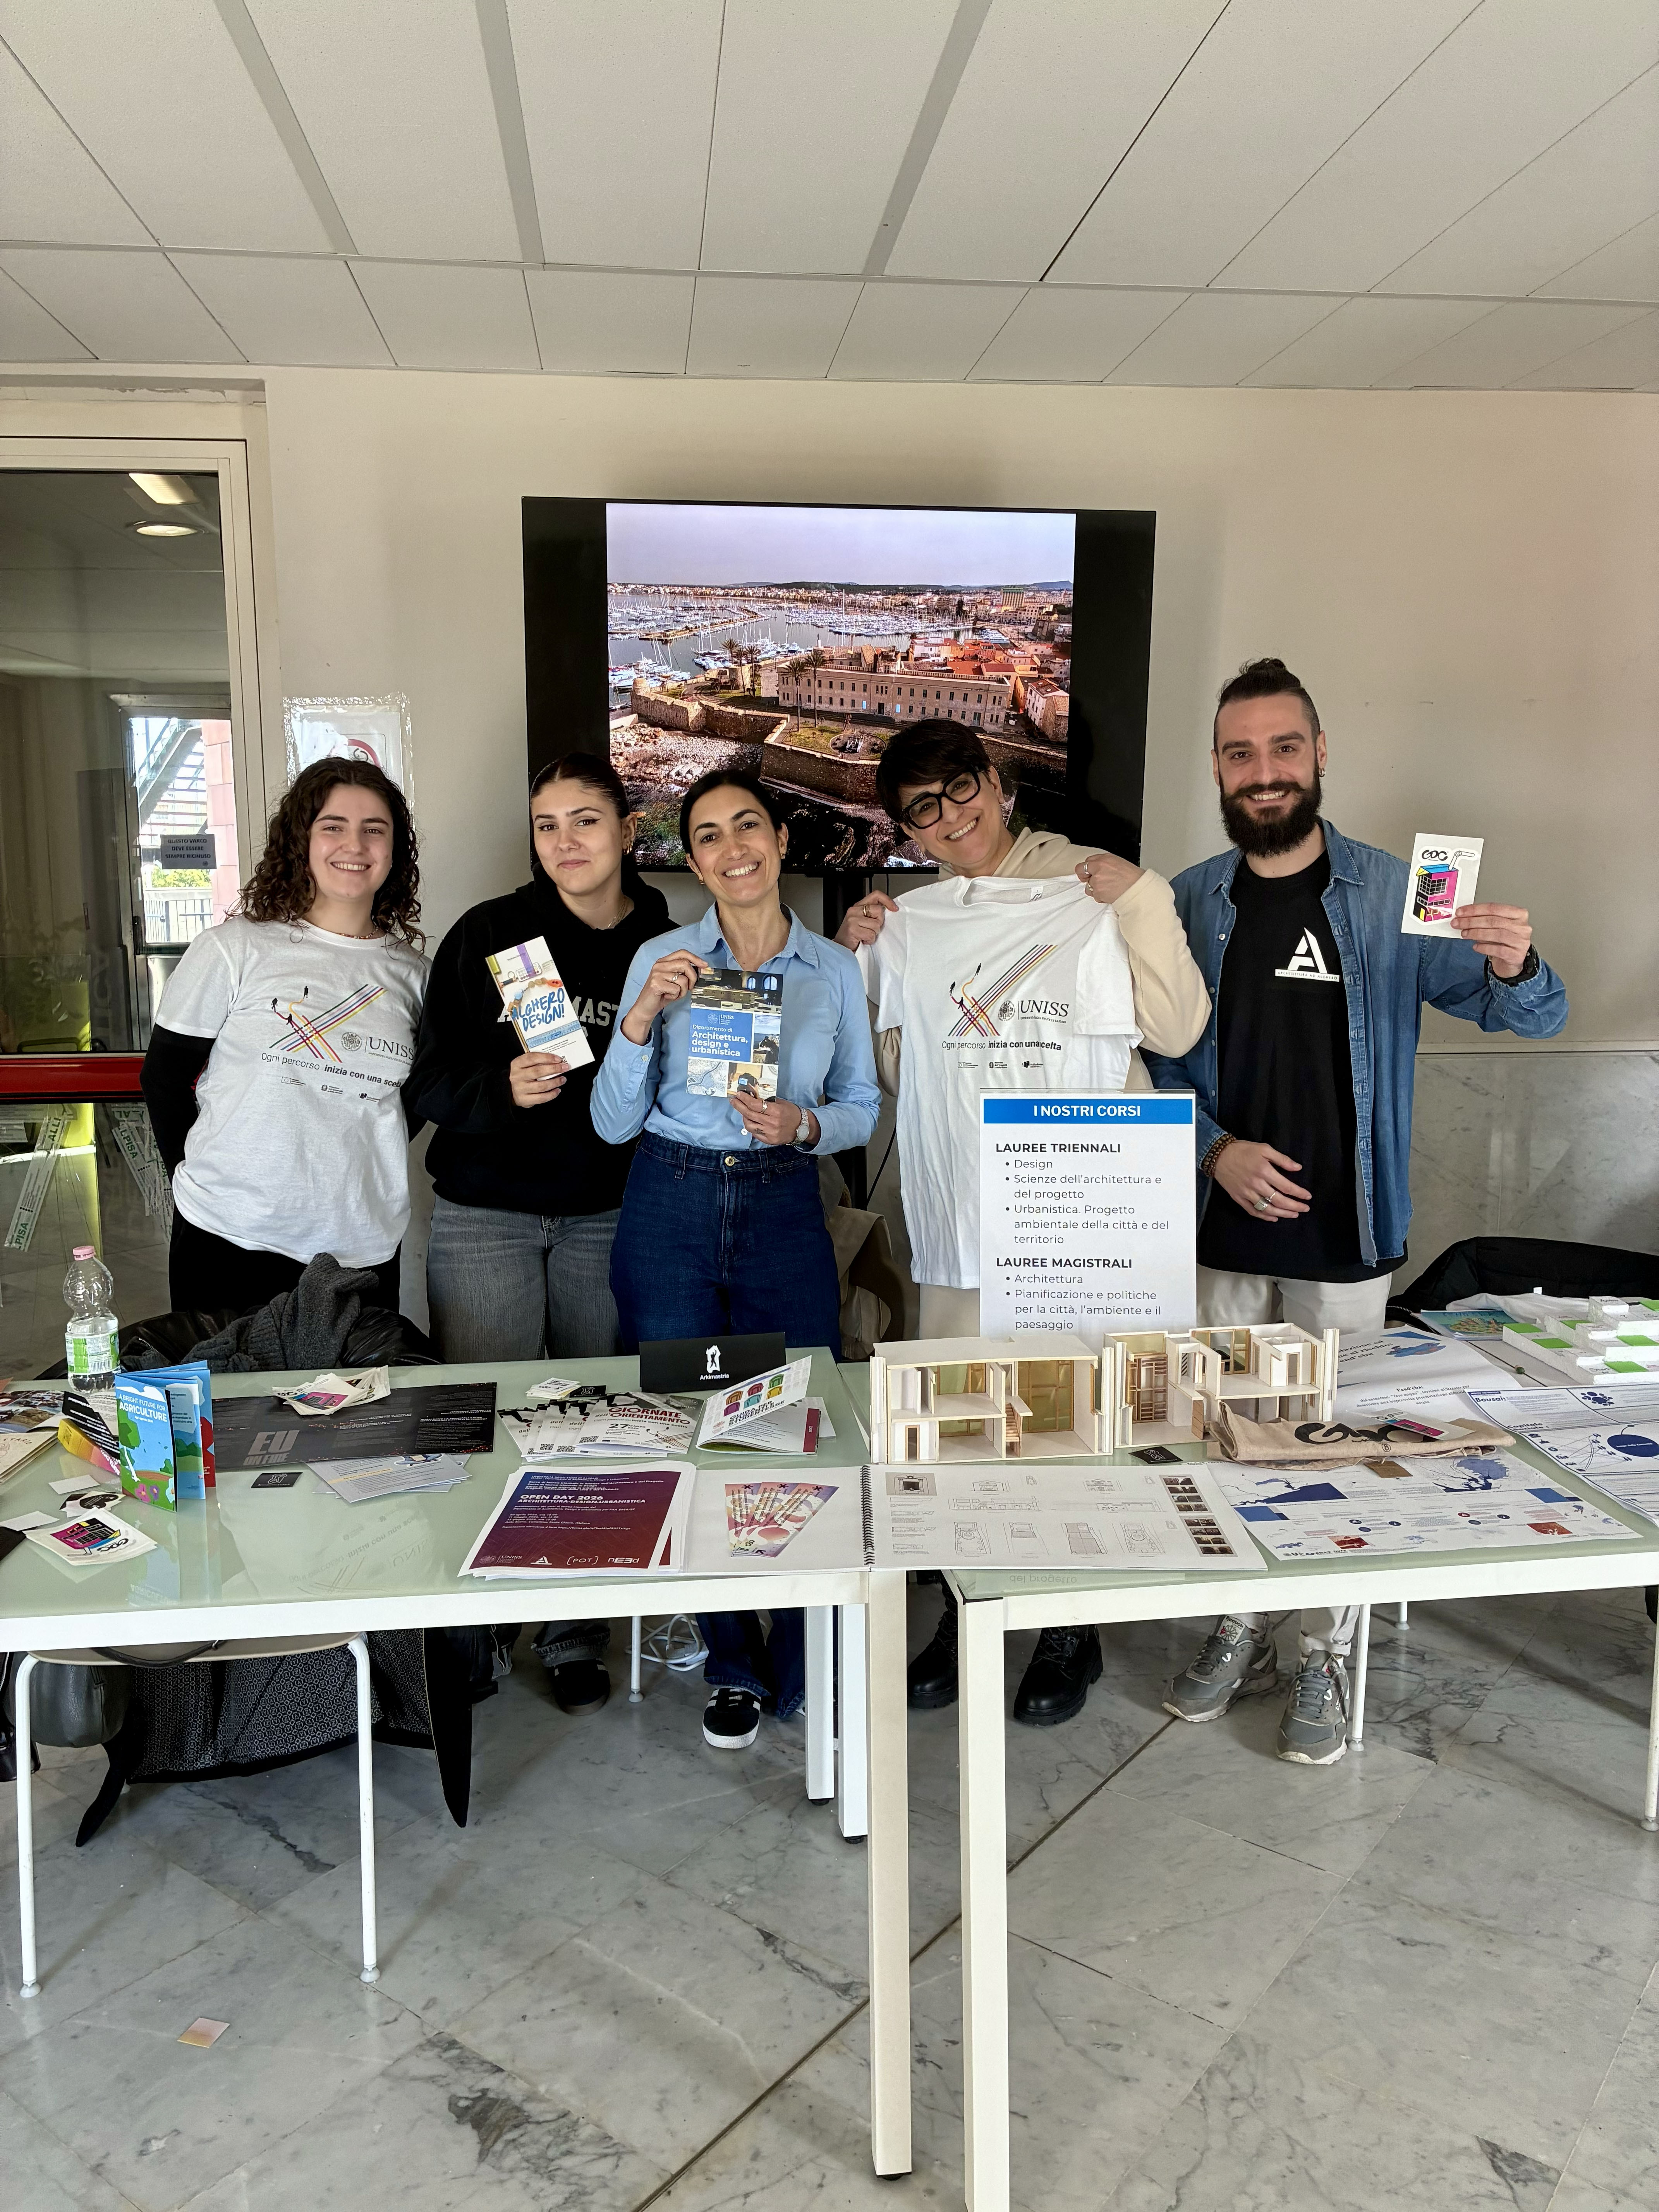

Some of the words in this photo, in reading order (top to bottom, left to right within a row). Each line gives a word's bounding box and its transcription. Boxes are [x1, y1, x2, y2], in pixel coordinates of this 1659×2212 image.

[512, 988, 565, 1020] ALGHERO
[1020, 1000, 1069, 1017] UNISS
[523, 1004, 564, 1032] DESIGN!
[692, 1031, 748, 1044] Architettura,
[369, 1037, 414, 1060] UNISS
[692, 1040, 721, 1048] design
[942, 1041, 955, 1050] Ogni
[958, 1042, 985, 1050] percorso
[989, 1040, 1007, 1049] inizia
[691, 1046, 740, 1057] urbanistica
[261, 1053, 280, 1063] Ogni
[282, 1056, 319, 1070] percorso
[325, 1065, 347, 1075] inizia
[350, 1071, 364, 1080] con
[367, 1074, 381, 1084] una
[1034, 1106, 1037, 1116] I
[1041, 1106, 1093, 1117] NOSTRI
[1097, 1106, 1140, 1117] CORSI
[996, 1144, 1047, 1153] LAUREE
[1051, 1144, 1121, 1153] TRIENNALI
[1014, 1159, 1053, 1170] Design
[1014, 1175, 1056, 1184] Scienze
[1060, 1175, 1151, 1184] dell'architettura
[1014, 1190, 1030, 1199] del
[1035, 1190, 1084, 1200] progetto
[1015, 1205, 1081, 1214] Urbanistica.
[1085, 1206, 1135, 1216] Progetto
[1014, 1220, 1078, 1230] ambientale
[1082, 1220, 1109, 1230] della
[1112, 1220, 1137, 1230] città
[1151, 1221, 1168, 1230] del
[1014, 1235, 1064, 1244] territorio
[996, 1258, 1048, 1267] LAUREE
[1052, 1258, 1132, 1268] MAGISTRALI
[1015, 1274, 1083, 1284] Architettura
[1015, 1290, 1093, 1300] Pianificazione
[1107, 1290, 1157, 1301] politiche
[1015, 1305, 1033, 1315] per
[1037, 1305, 1046, 1314] la
[1049, 1305, 1078, 1315] città,
[1081, 1305, 1141, 1315] l'ambiente
[1155, 1306, 1161, 1315] il
[1015, 1320, 1073, 1331] paesaggio
[123, 1395, 138, 1404] BRIGHT
[139, 1399, 156, 1409] FUTURE
[157, 1403, 165, 1411] FOR
[119, 1401, 167, 1422] AGRICULTURE
[609, 1407, 682, 1418] GIORNATE
[248, 1430, 300, 1455] EU
[244, 1456, 263, 1465] ON
[261, 1453, 289, 1464] FIRE
[1226, 1616, 1243, 1628] Reebok
